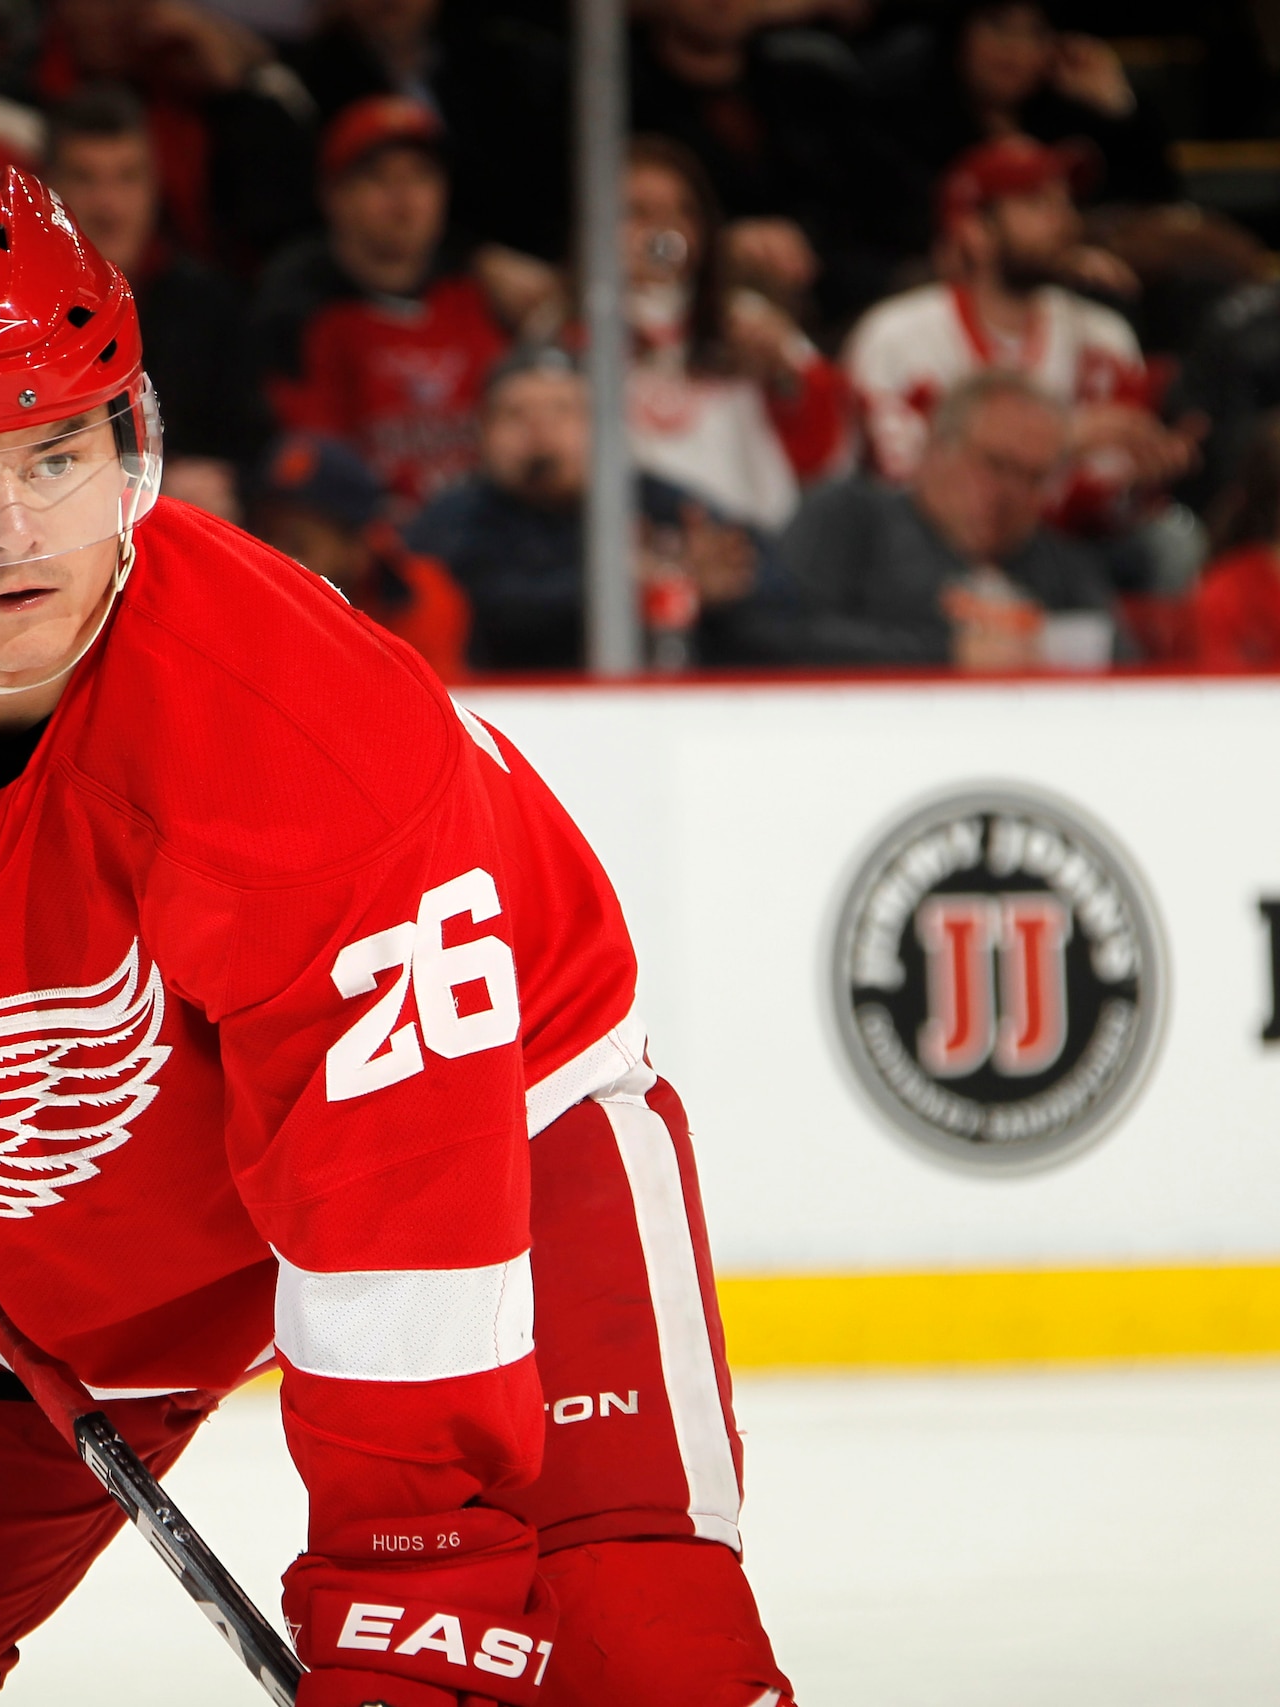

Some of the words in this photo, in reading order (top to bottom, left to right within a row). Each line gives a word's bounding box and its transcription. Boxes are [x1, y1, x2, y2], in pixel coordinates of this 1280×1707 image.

[326, 866, 521, 1103] 26
[915, 892, 1072, 1078] JJ
[544, 1390, 639, 1425] ON
[372, 1534, 425, 1552] HUDS
[436, 1531, 461, 1549] 26
